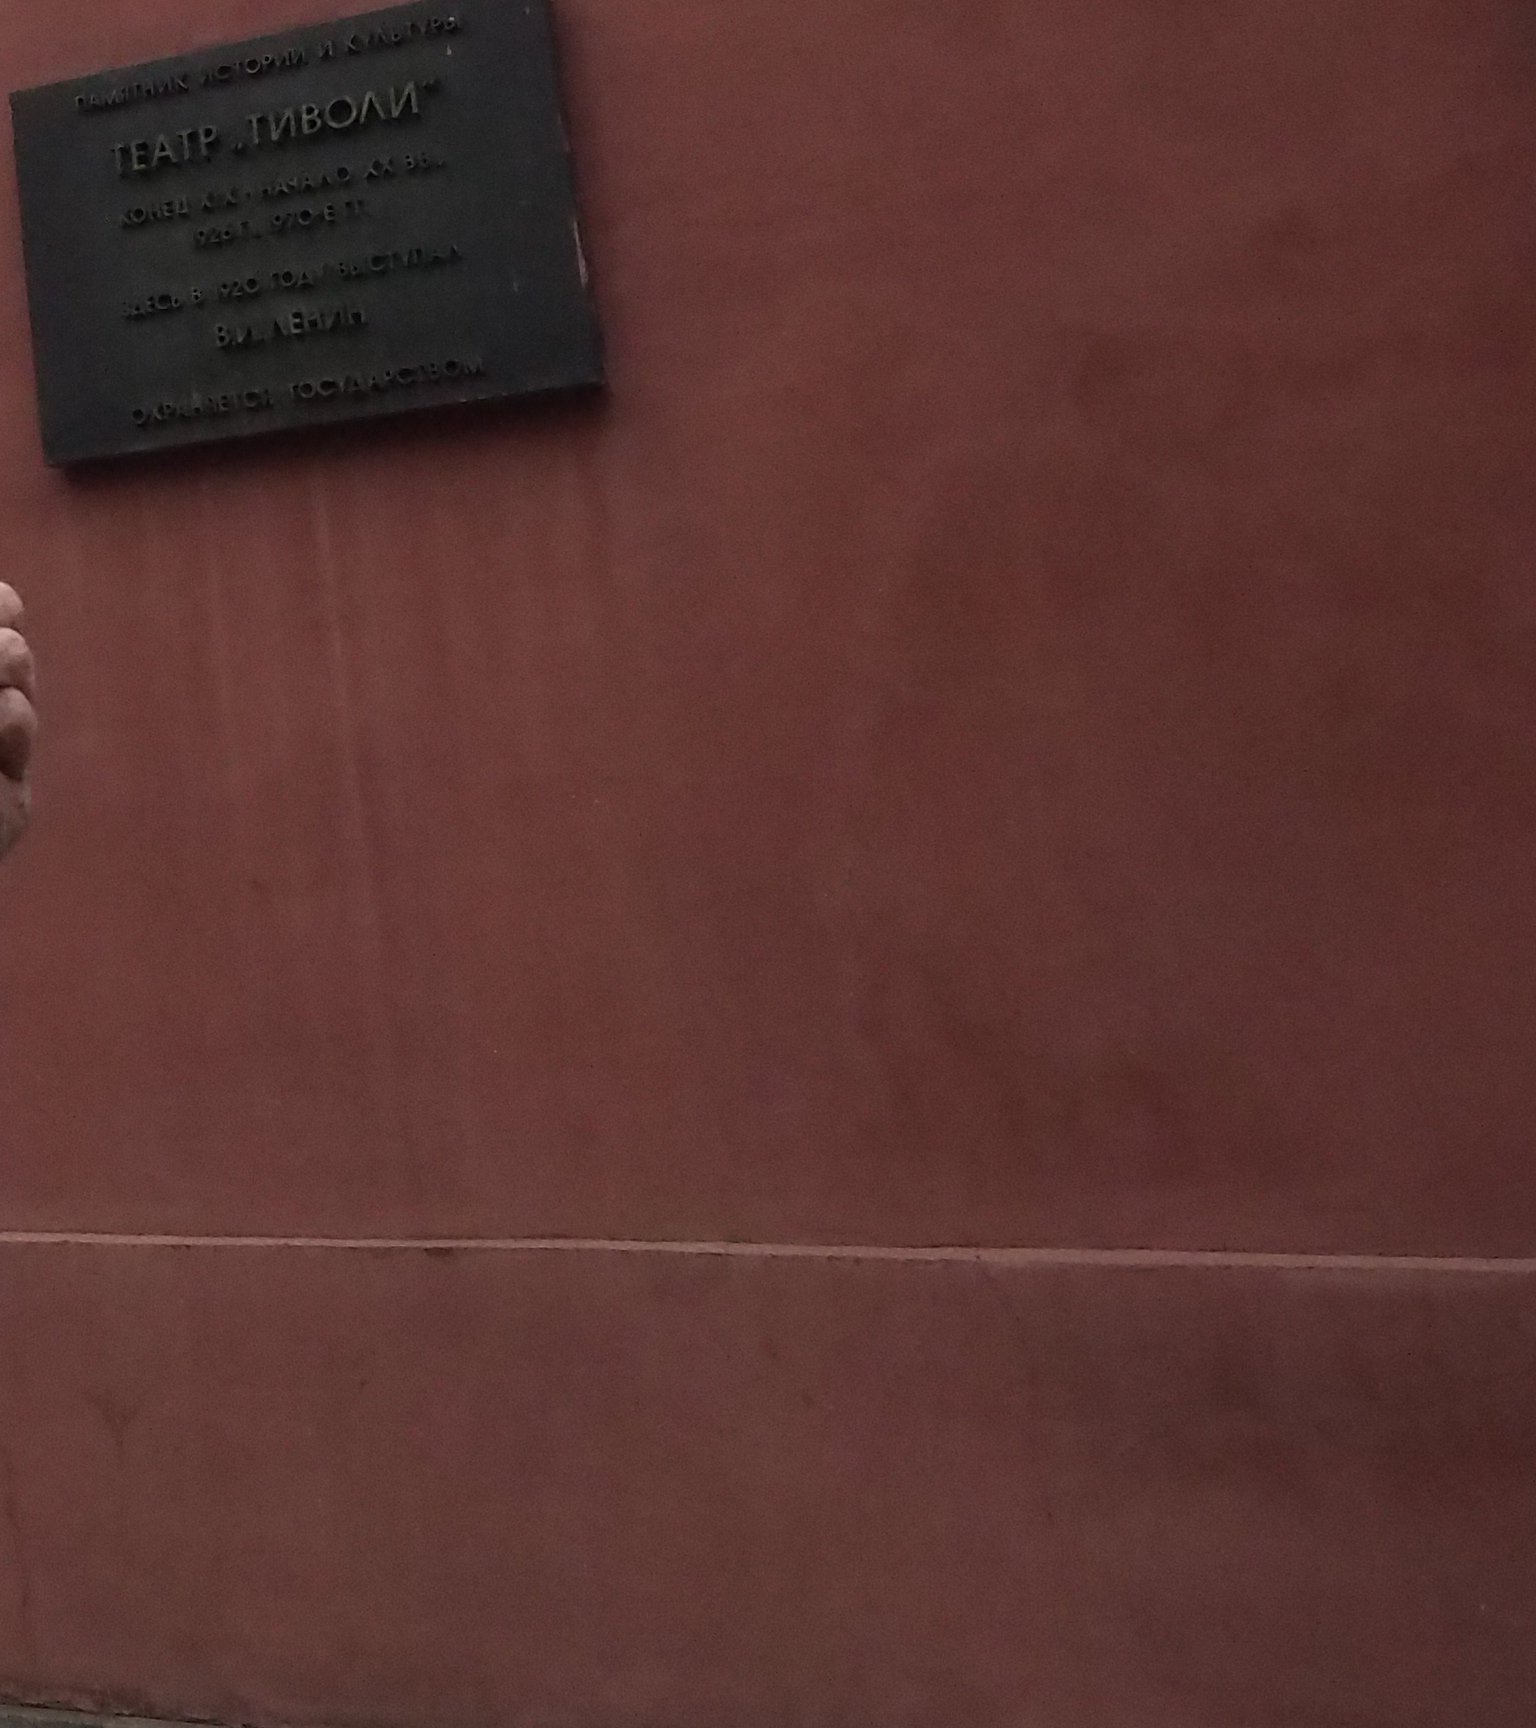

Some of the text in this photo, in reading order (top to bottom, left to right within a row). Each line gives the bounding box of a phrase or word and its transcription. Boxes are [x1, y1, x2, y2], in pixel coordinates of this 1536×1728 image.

[201, 46, 305, 86] ИСТОРИИ
[317, 39, 334, 58] И
[344, 14, 461, 51] КУЛЬТУРЫ
[110, 124, 219, 174] ТЕАТР
[121, 244, 460, 319] ЗДЕСЬ В 1920 ГОДУ ВЫСТУПАЛ
[268, 302, 368, 336] ЛЕНИН
[131, 358, 483, 425] ОХРАНЯЕТСЯ ГОСУДАРСТВОМ
